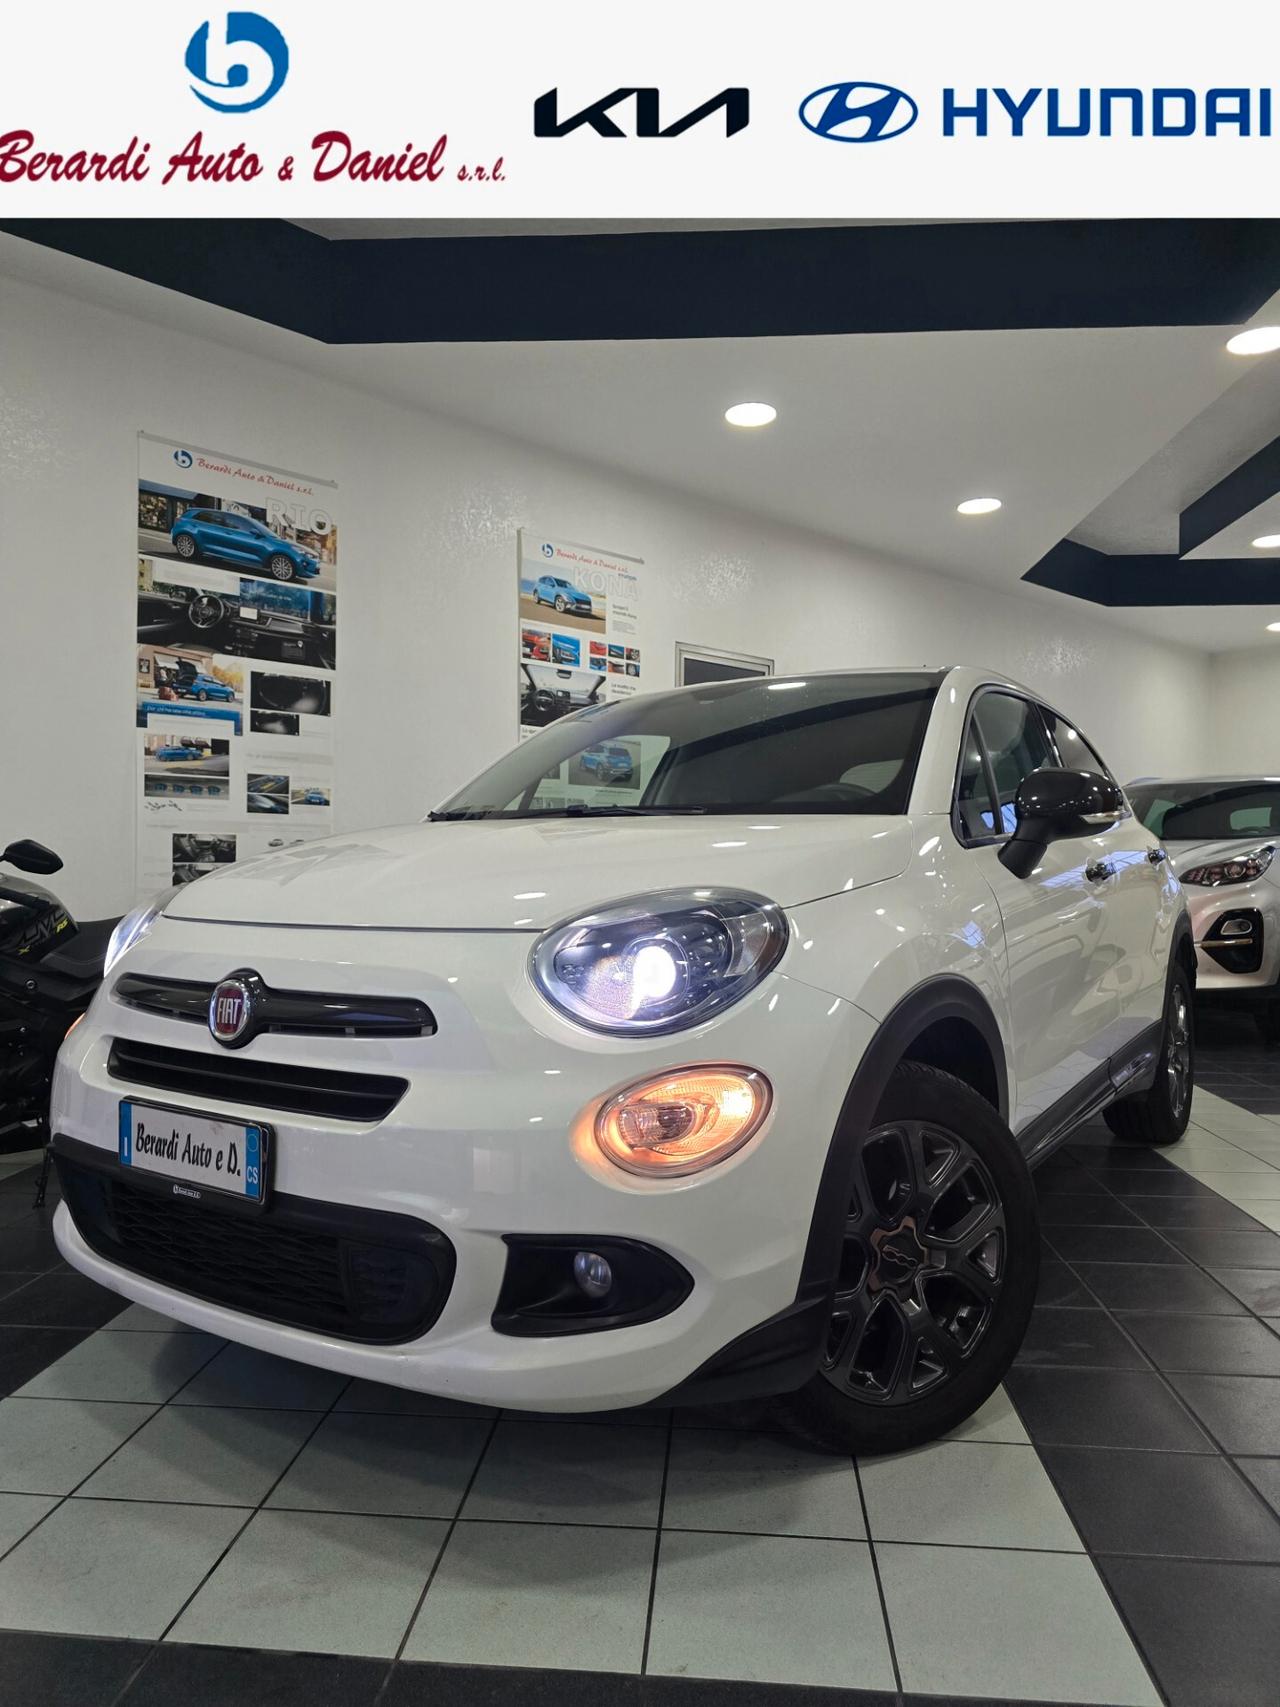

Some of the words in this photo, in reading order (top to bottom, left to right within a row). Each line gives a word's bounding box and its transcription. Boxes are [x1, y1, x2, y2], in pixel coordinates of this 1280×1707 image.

[196, 458, 232, 475] Berardi
[232, 468, 256, 482] Auto
[264, 475, 296, 491] Daniel
[266, 498, 332, 535] RIO
[573, 567, 640, 602] KONA
[217, 997, 242, 1025] FIAT
[135, 1121, 179, 1162] Berardi
[182, 1132, 212, 1169] Auto
[215, 1150, 224, 1172] e
[227, 1141, 242, 1178] D.
[246, 1166, 260, 1185] CS
